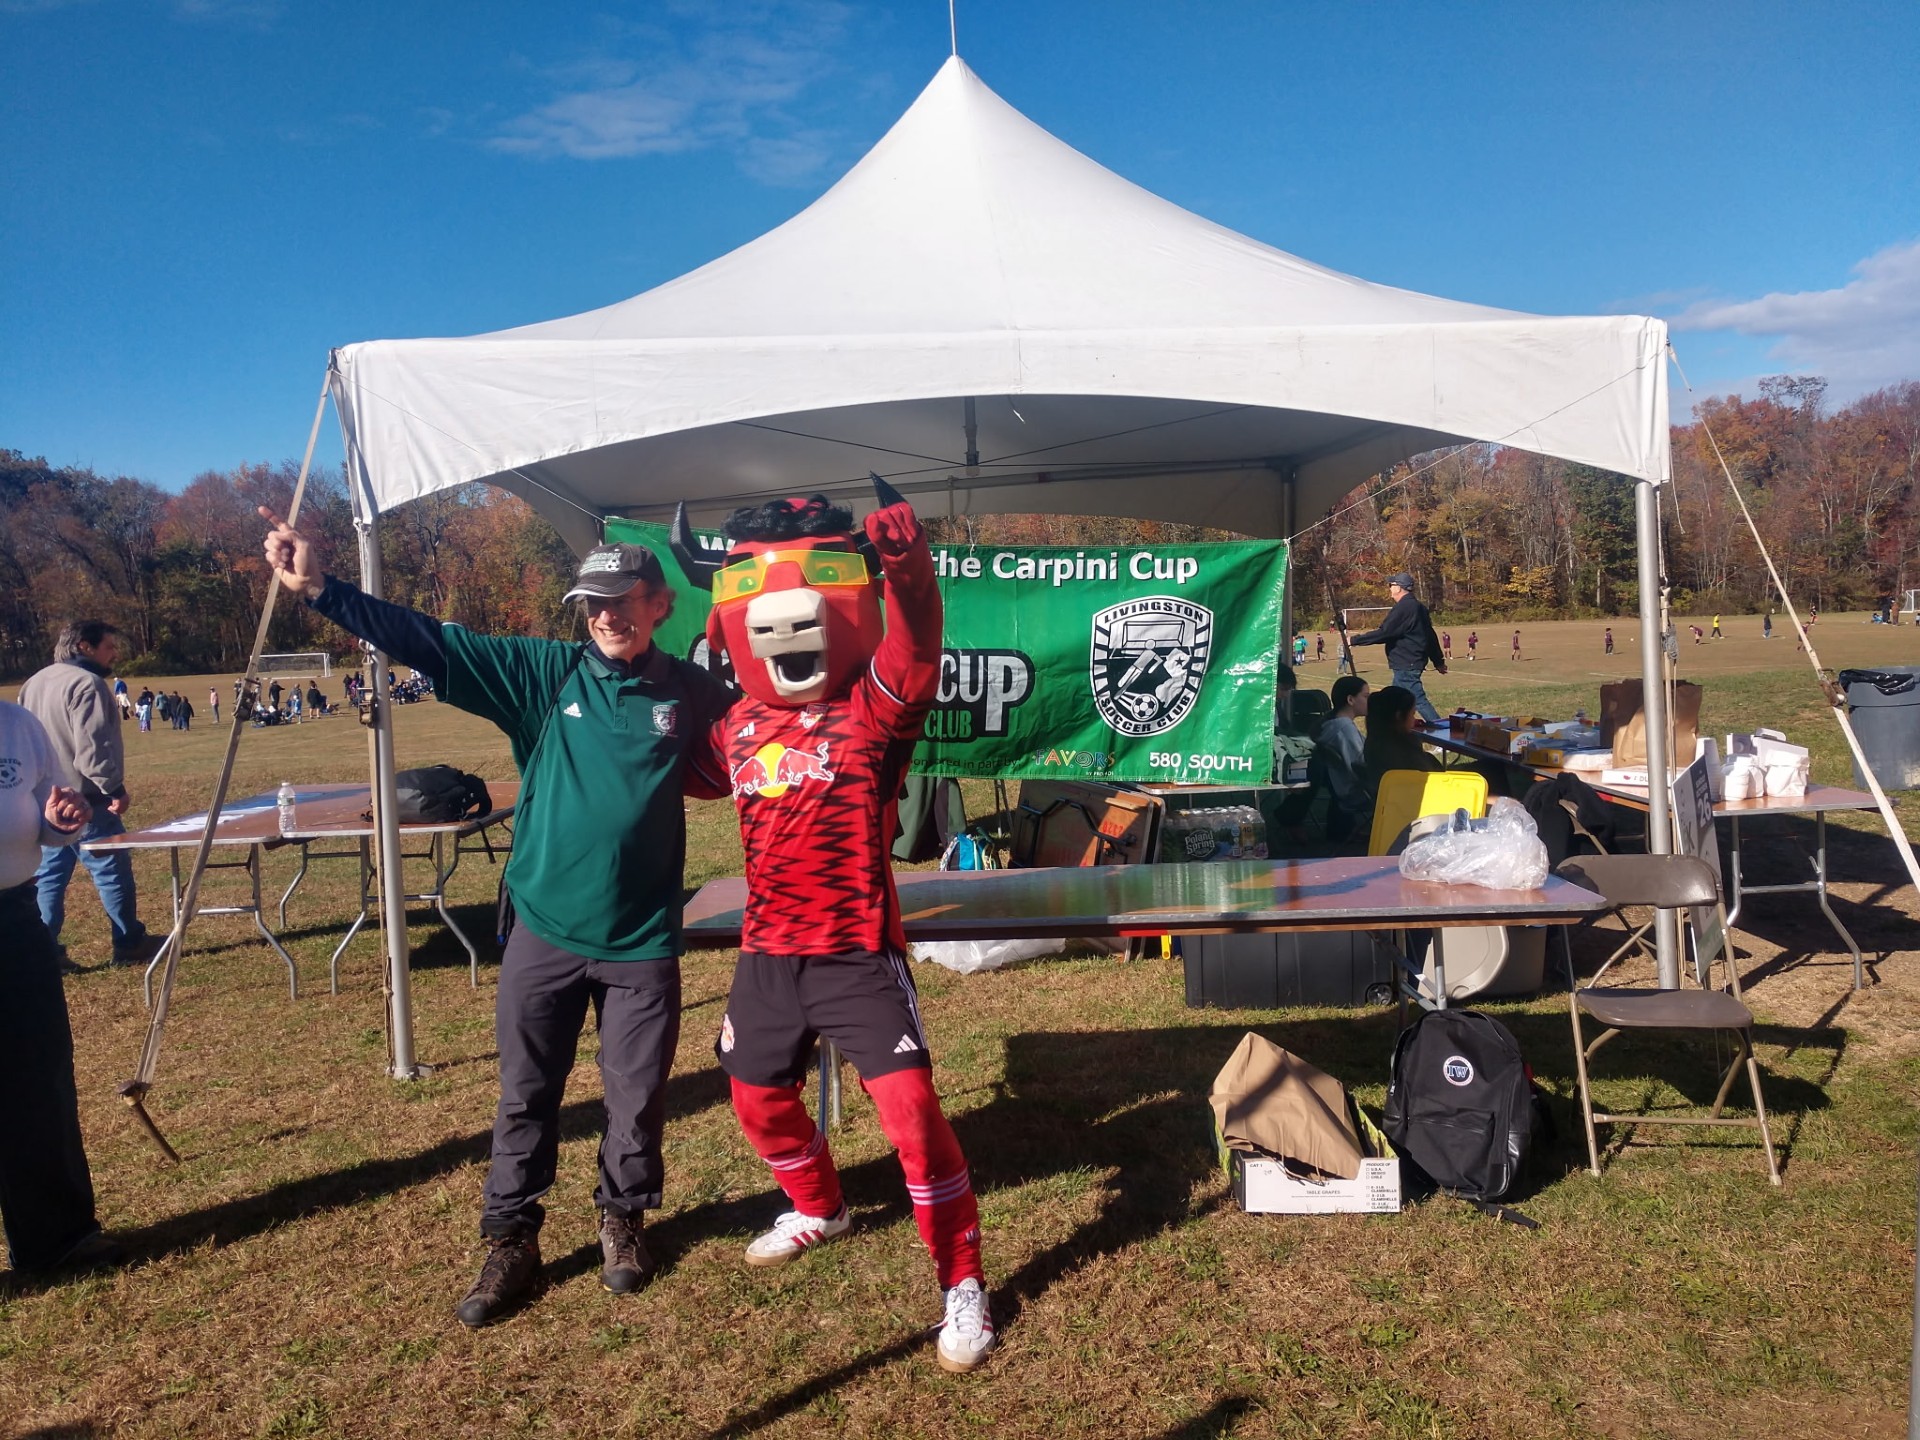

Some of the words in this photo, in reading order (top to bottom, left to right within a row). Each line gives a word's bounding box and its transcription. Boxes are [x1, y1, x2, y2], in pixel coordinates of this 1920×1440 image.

[930, 551, 982, 578] the
[992, 552, 1118, 586] Carpini
[1129, 552, 1198, 584] Cup
[1104, 601, 1204, 624] LIVINGSTON
[936, 652, 1030, 731] CUP
[924, 708, 972, 739] CLUB
[1100, 697, 1151, 732] SOCCER
[1157, 695, 1191, 727] CLUB
[963, 759, 974, 769] in
[1036, 749, 1116, 769] FAVORS
[1149, 752, 1181, 767] 580
[1188, 754, 1253, 772] SOUTH
[1698, 792, 1711, 828] 26
[1184, 830, 1214, 845] Poland
[1186, 840, 1216, 854] Spring
